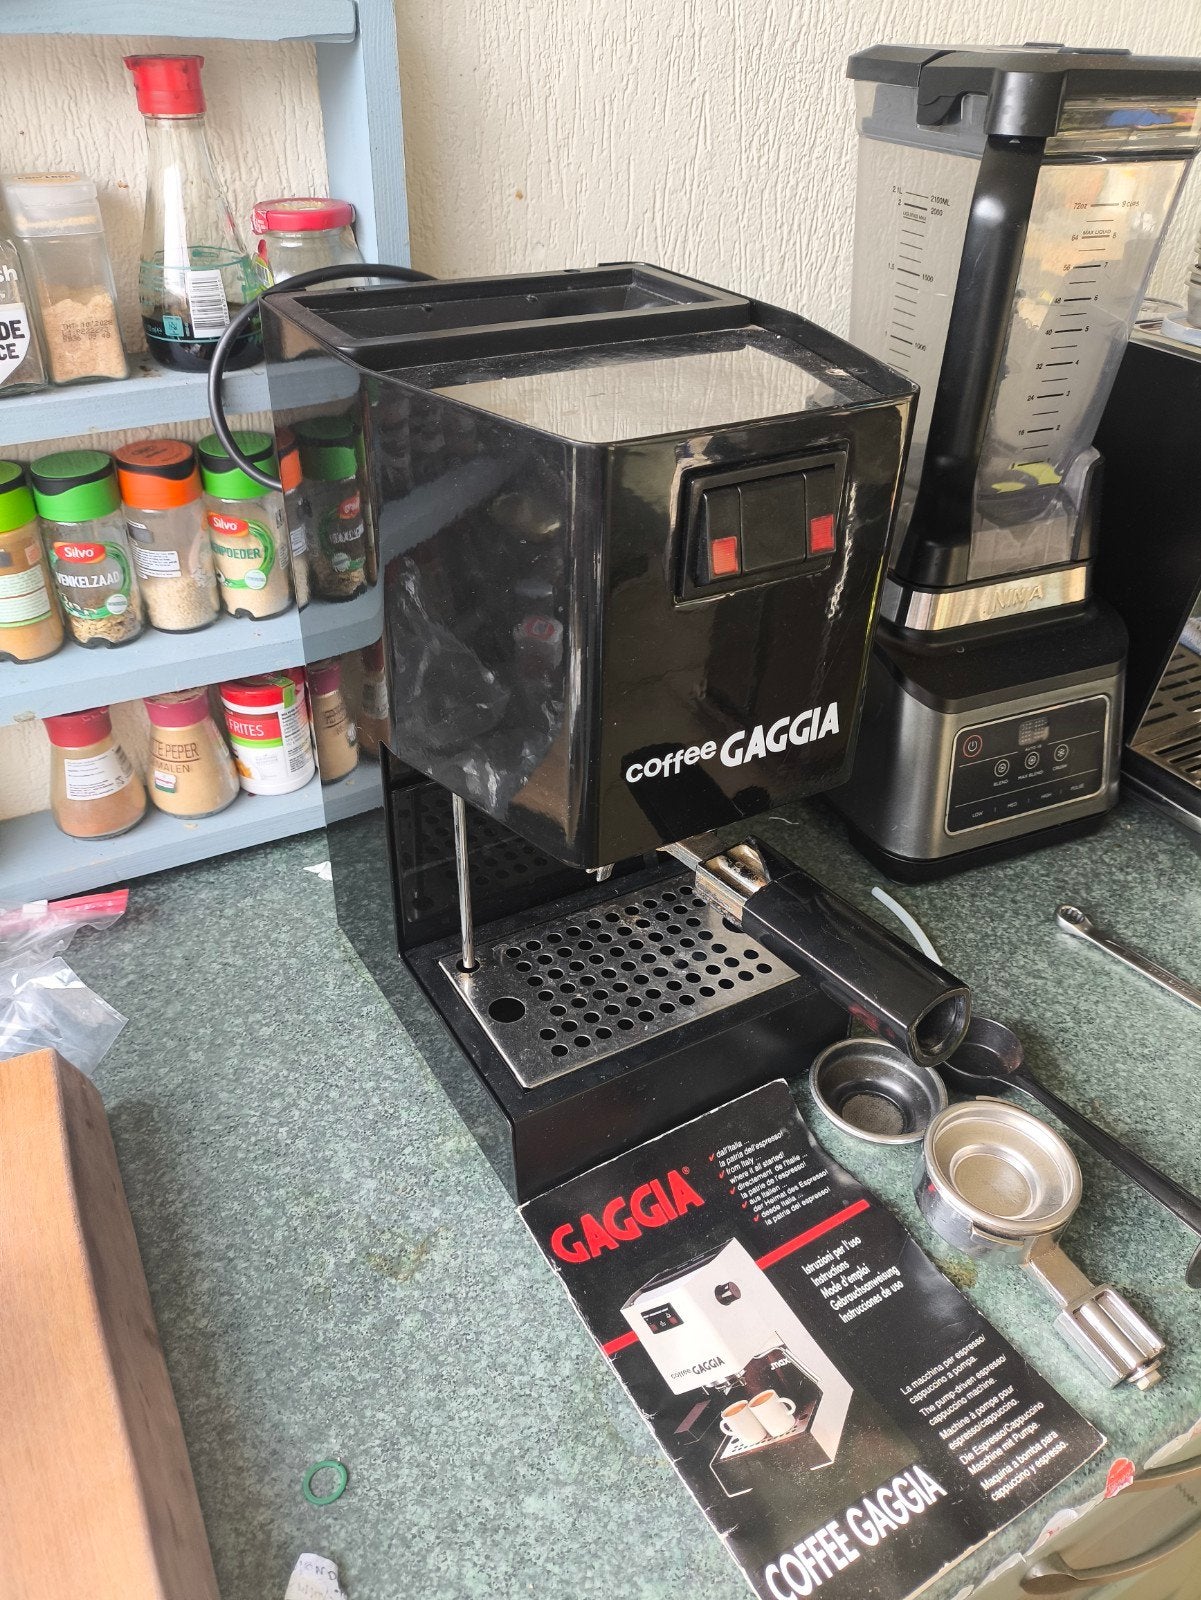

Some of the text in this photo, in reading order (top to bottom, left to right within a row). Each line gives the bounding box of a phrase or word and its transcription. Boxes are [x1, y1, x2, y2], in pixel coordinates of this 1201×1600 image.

[1103, 261, 1109, 269] 7
[0, 319, 25, 341] DE
[1027, 394, 1035, 402] 24
[213, 517, 238, 531] Silvo
[64, 547, 95, 558] Silvo
[55, 570, 120, 588] VENKELZAAD
[991, 584, 1043, 612] NINJA
[229, 719, 264, 737] FRITES
[625, 701, 840, 783] coffee GAGGIA
[165, 742, 200, 760] PEPER
[971, 810, 984, 818] LOW
[716, 1141, 743, 1158] dall'Italia
[719, 1131, 783, 1168] la patria dell'espresso!
[725, 1164, 741, 1175] from
[740, 1157, 754, 1168] Italy
[729, 1170, 749, 1184] where
[754, 1163, 762, 1172] all
[762, 1151, 784, 1168] started!
[737, 1168, 773, 1191] directement
[774, 1163, 783, 1172] de
[748, 1182, 766, 1197] patrie
[766, 1177, 775, 1186] de
[749, 1195, 761, 1205] aus
[761, 1185, 780, 1198] Italien
[753, 1169, 829, 1212] der Heimat des Espresso!
[551, 1169, 705, 1263] GAGGIA
[761, 1204, 781, 1218] desde
[780, 1196, 797, 1207] Italia
[773, 1208, 791, 1223] patria
[790, 1202, 801, 1212] del
[801, 1186, 831, 1206] espresso!
[801, 1236, 862, 1275] Istruzioni per l'uso
[810, 1260, 850, 1287] Instructions
[820, 1262, 871, 1299] Mode d'emploi
[829, 1265, 901, 1311] Gebrauchsanweisung
[839, 1280, 904, 1324] Instrucciones de uso
[670, 1356, 726, 1380] coffee GAGGIA
[900, 1333, 986, 1396] La macchina per espresso/
[909, 1355, 978, 1404] cappuccino a pompa.
[919, 1353, 1007, 1417] The pump-driven espresso/
[929, 1377, 998, 1426] cappuccino machine.
[939, 1384, 1015, 1440] Machine à pompe pour
[948, 1398, 1020, 1450] espresso/cappuccino.
[959, 1402, 1044, 1465] Die Espresso/Cappuccino
[967, 1422, 1041, 1476] Maschine mit Pumpe.
[980, 1430, 1059, 1491] Maquina a bomba para
[991, 1440, 1069, 1501] cappuccino y espresso.
[765, 1465, 948, 1600] COFFEE GAGGIA
